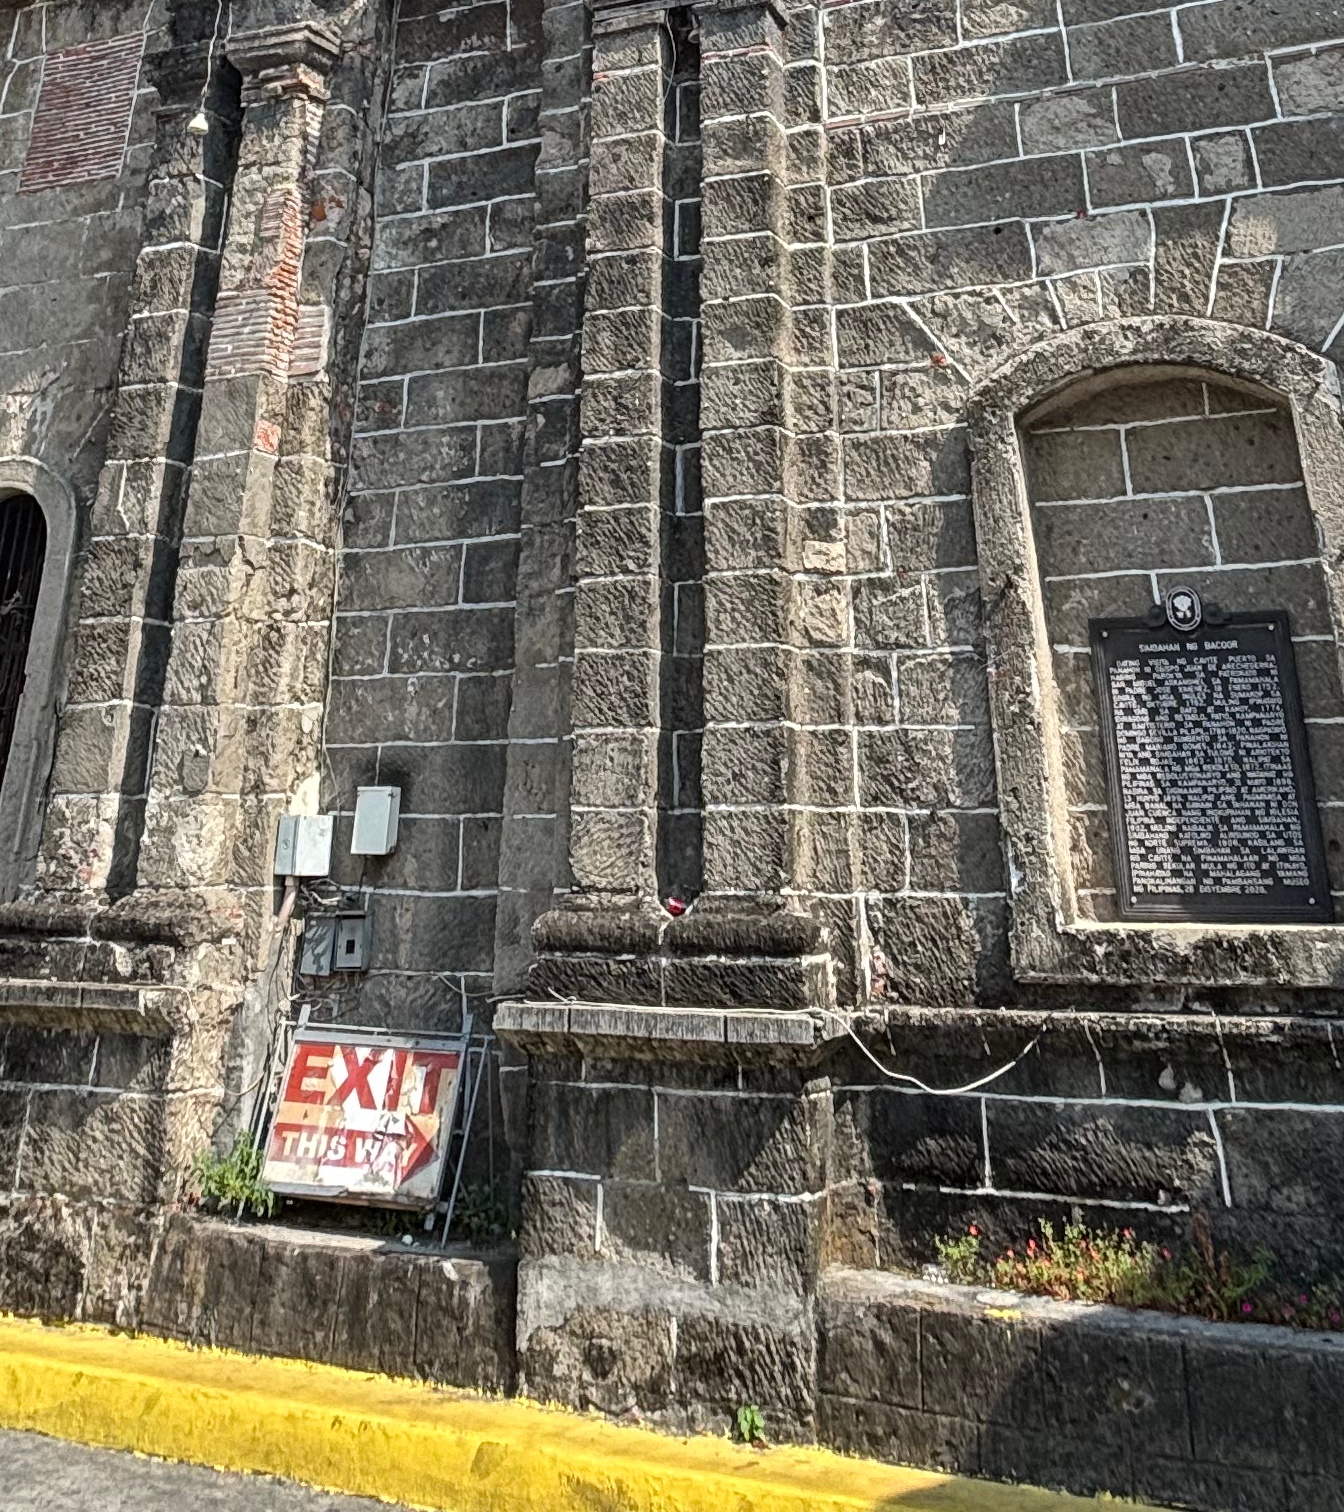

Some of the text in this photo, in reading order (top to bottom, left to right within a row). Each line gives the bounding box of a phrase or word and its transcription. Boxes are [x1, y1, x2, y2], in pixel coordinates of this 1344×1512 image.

[283, 1044, 461, 1114] EXIT
[281, 1131, 419, 1169] THIS WAY
